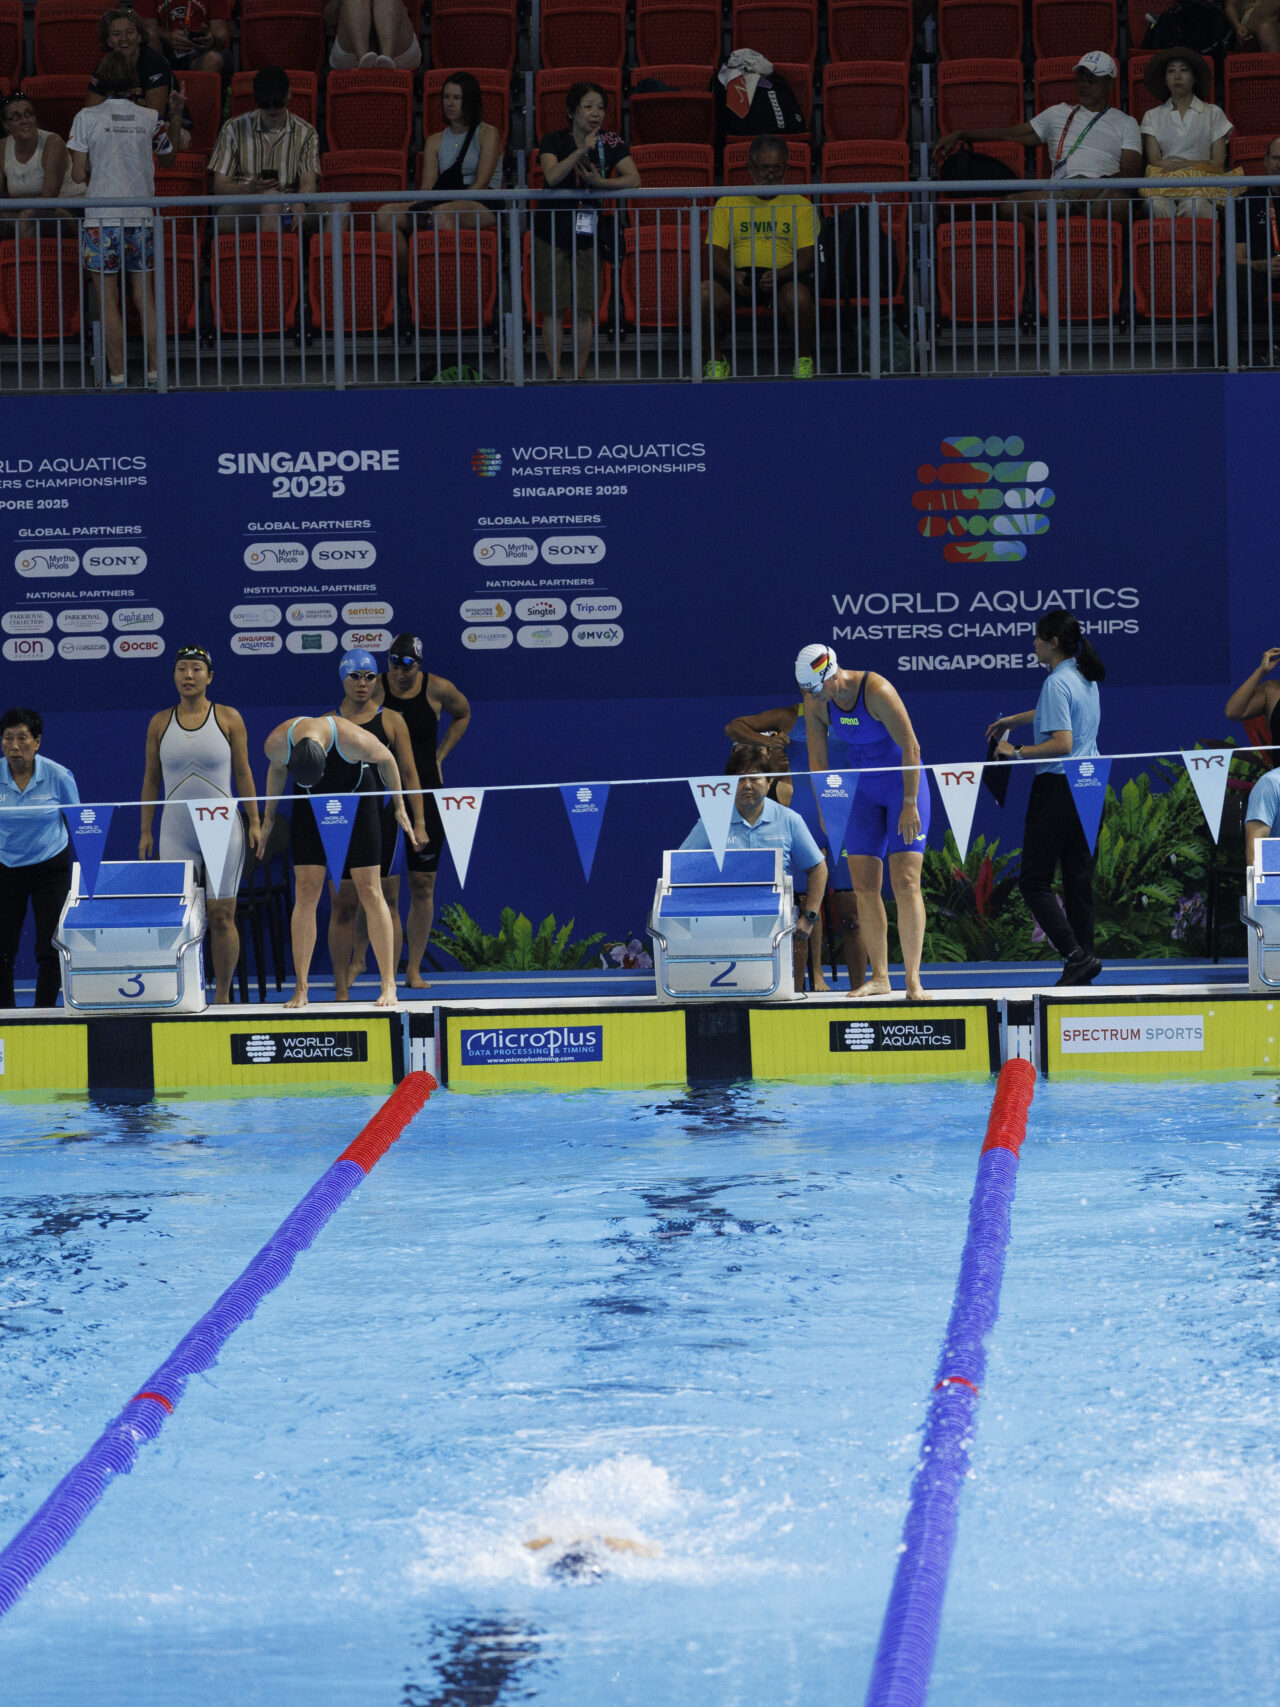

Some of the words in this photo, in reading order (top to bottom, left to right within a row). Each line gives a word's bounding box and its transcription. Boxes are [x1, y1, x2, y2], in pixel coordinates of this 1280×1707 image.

[740, 221, 778, 233] SWIM
[782, 222, 790, 234] 3
[512, 445, 592, 460] WORLD
[597, 442, 706, 459] AQUATICS
[38, 456, 147, 473] AQUATICS
[217, 449, 400, 475] SINGAPORE
[511, 465, 581, 476] MASTERS
[584, 463, 706, 475] CHAMPIONSHIPS
[25, 476, 148, 489] CHAMPIONSHIPS
[272, 475, 346, 498] 2025
[513, 486, 593, 497] SINGAPORE
[595, 485, 628, 496] 2025
[36, 499, 69, 509] 2025
[247, 521, 299, 531] GLOBAL
[301, 519, 371, 530] PARTNERS
[478, 516, 530, 526] GLOBAL
[532, 514, 601, 524] PARTNERS
[18, 527, 70, 537] GLOBAL
[72, 525, 143, 536] PARTNERS
[278, 548, 305, 557] Myrtha
[508, 543, 534, 552] Myrtha
[548, 545, 600, 555] SONY
[49, 555, 76, 563] Myrtha
[278, 556, 298, 564] Pools
[318, 550, 369, 560] SONY
[49, 562, 69, 570] Pools
[89, 556, 140, 567] SONY
[486, 580, 538, 588] NATIONAL
[539, 578, 595, 587] PARTNERS
[26, 591, 78, 599] NATIONAL
[80, 589, 135, 598] PARTNERS
[243, 585, 320, 594] INSTITUTIONAL
[321, 584, 377, 593] PARTNERS
[832, 592, 959, 615] WORLD
[968, 587, 1140, 613] AQUATICS
[348, 607, 385, 616] sentosa
[528, 607, 556, 617] Singtel
[576, 603, 617, 613] Trip.com
[587, 628, 619, 642] MVGX
[832, 624, 943, 640] MASTERS
[947, 620, 1140, 638] CHAMPISHIPS
[237, 635, 275, 643] SINGAPORE
[131, 641, 158, 650] OCBC
[897, 654, 1023, 671] SINGAPORE
[840, 716, 860, 726] arena
[1190, 755, 1224, 771] TYR
[941, 770, 975, 786] TYR
[697, 783, 731, 798] TYR
[442, 795, 475, 811] TYR
[195, 806, 229, 821] TYR
[709, 961, 738, 987] 2
[118, 973, 145, 998] 3
[882, 1025, 934, 1035] WORLD
[1063, 1028, 1141, 1042] SPECTRUM
[1145, 1027, 1203, 1040] SPORTS
[282, 1037, 335, 1047] WORLD
[881, 1035, 952, 1046] AQUATICS
[283, 1047, 354, 1058] AQUATICS
[493, 1047, 549, 1055] PROCESSING
[487, 1056, 575, 1064] www.microplustiming.com
